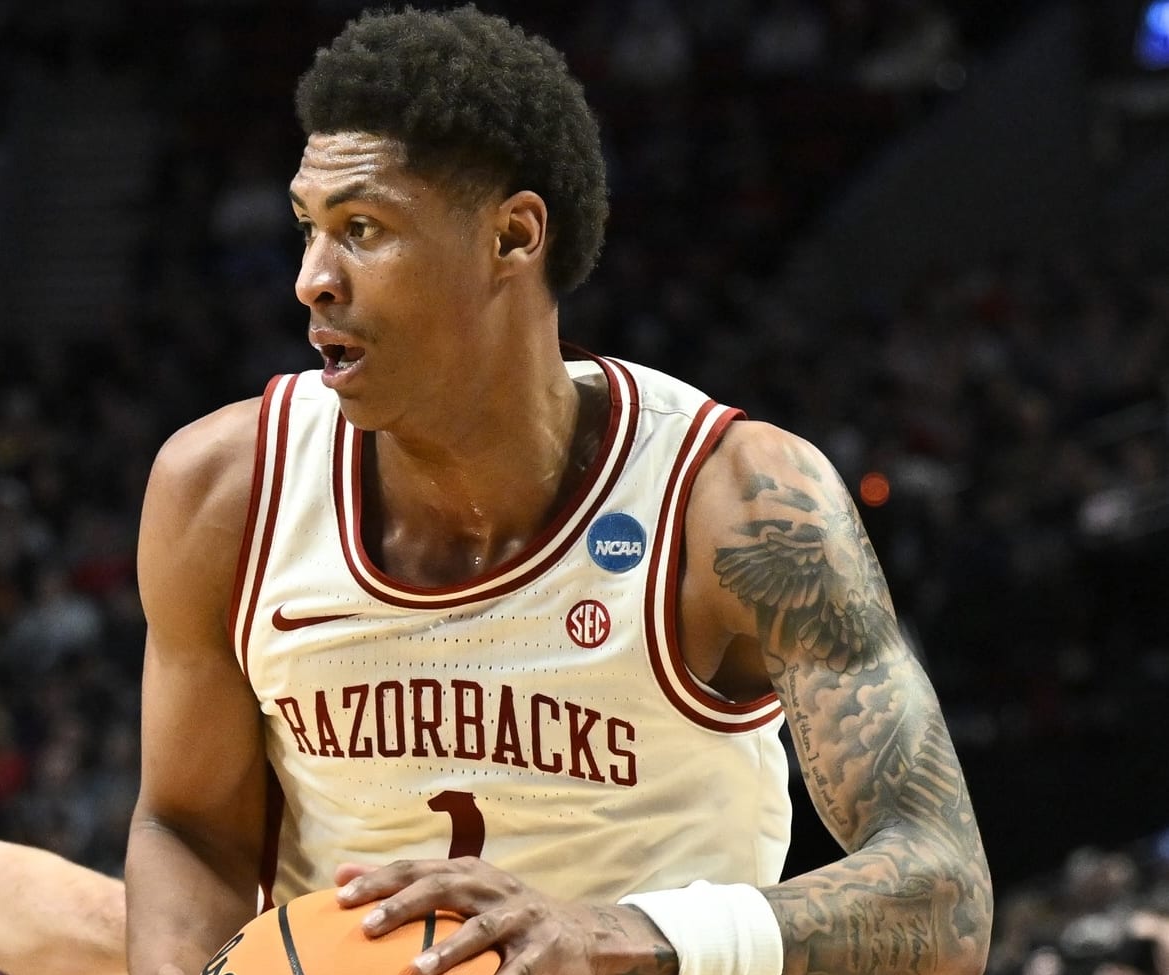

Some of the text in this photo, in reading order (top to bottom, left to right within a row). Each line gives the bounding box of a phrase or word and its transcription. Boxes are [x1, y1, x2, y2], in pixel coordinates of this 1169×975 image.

[595, 540, 642, 557] NCAA
[571, 603, 606, 644] SEC
[275, 678, 638, 788] RAZORBACKS
[427, 790, 486, 860] 1
